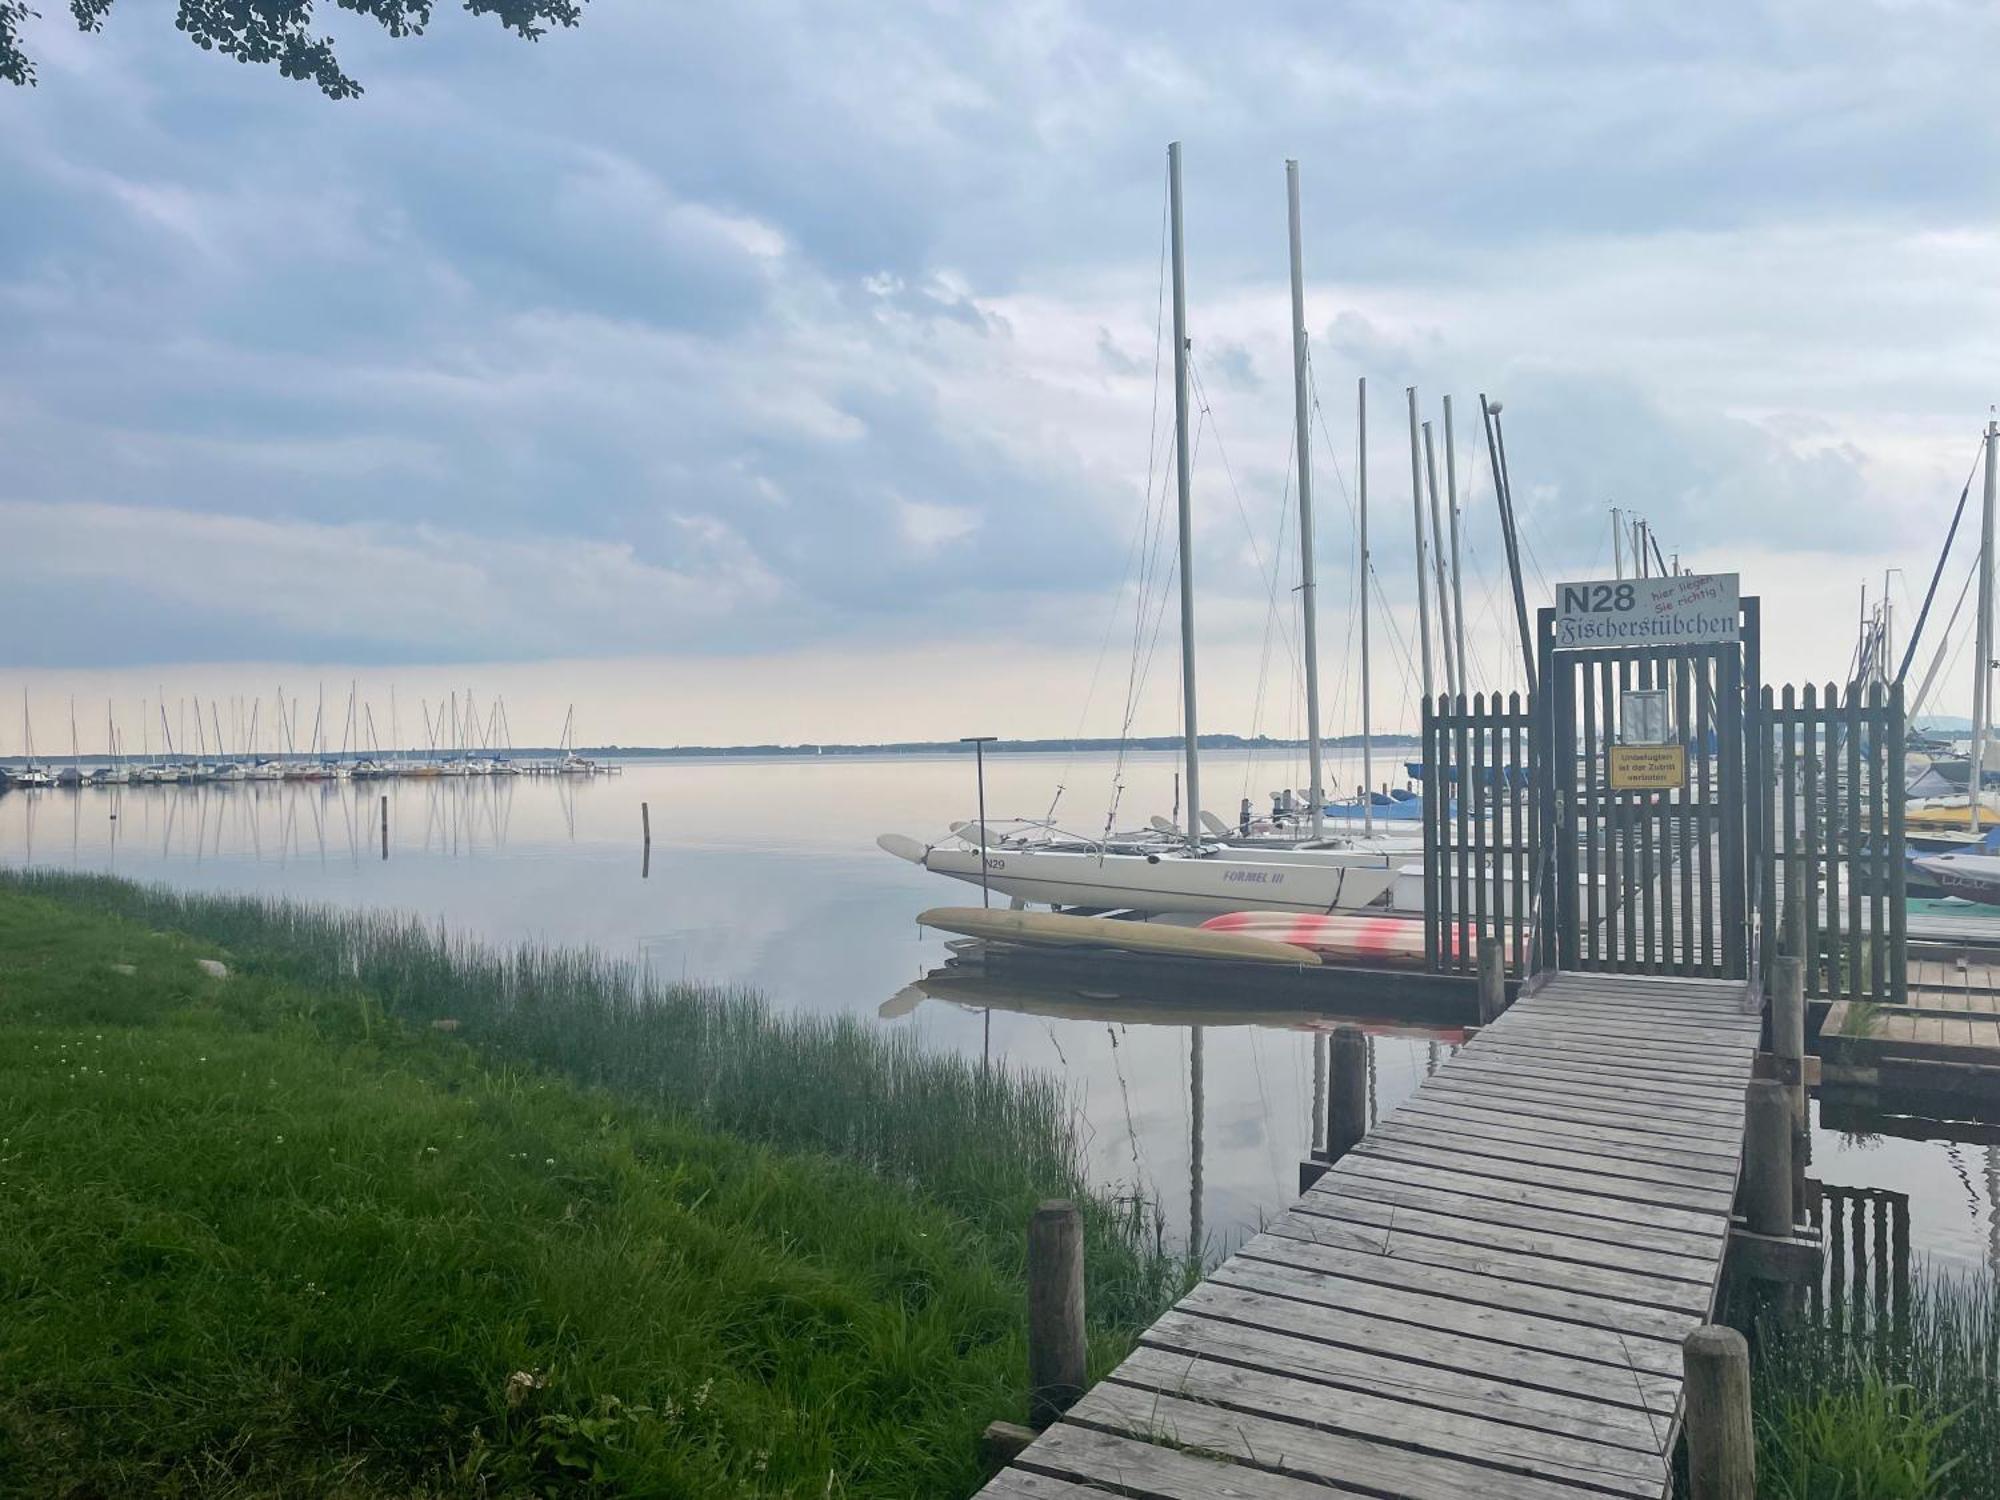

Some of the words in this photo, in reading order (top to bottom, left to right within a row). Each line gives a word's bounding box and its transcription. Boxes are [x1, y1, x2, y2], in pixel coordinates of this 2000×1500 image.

[1564, 584, 1636, 614] N28
[1651, 588, 1674, 601] hier
[1655, 602, 1673, 614] Sie
[1560, 613, 1734, 645] Fischerstübchen
[1648, 762, 1676, 771] Zutritt
[984, 858, 1006, 870] N29
[1223, 870, 1269, 882] FORMEL
